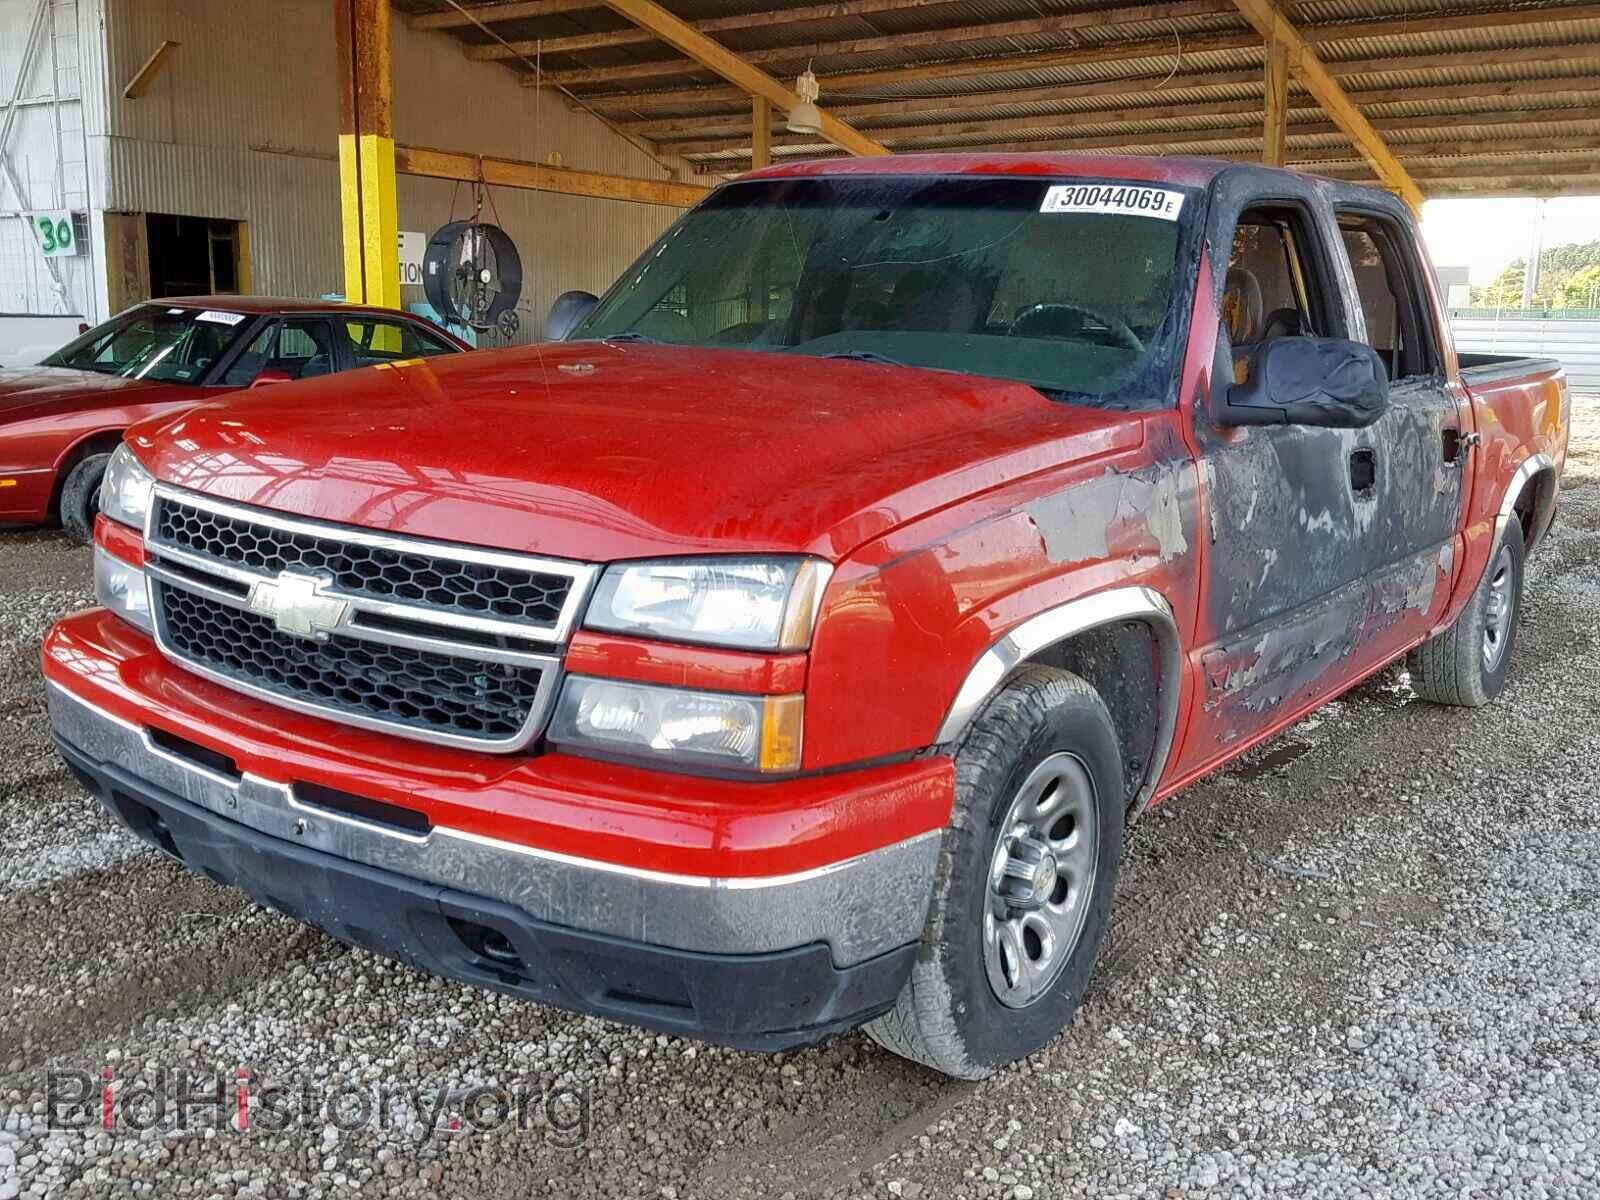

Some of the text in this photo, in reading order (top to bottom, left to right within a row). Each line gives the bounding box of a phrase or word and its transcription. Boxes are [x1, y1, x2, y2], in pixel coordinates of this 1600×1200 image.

[1061, 187, 1166, 211] 30044069
[1165, 201, 1174, 213] E
[39, 216, 72, 254] 30
